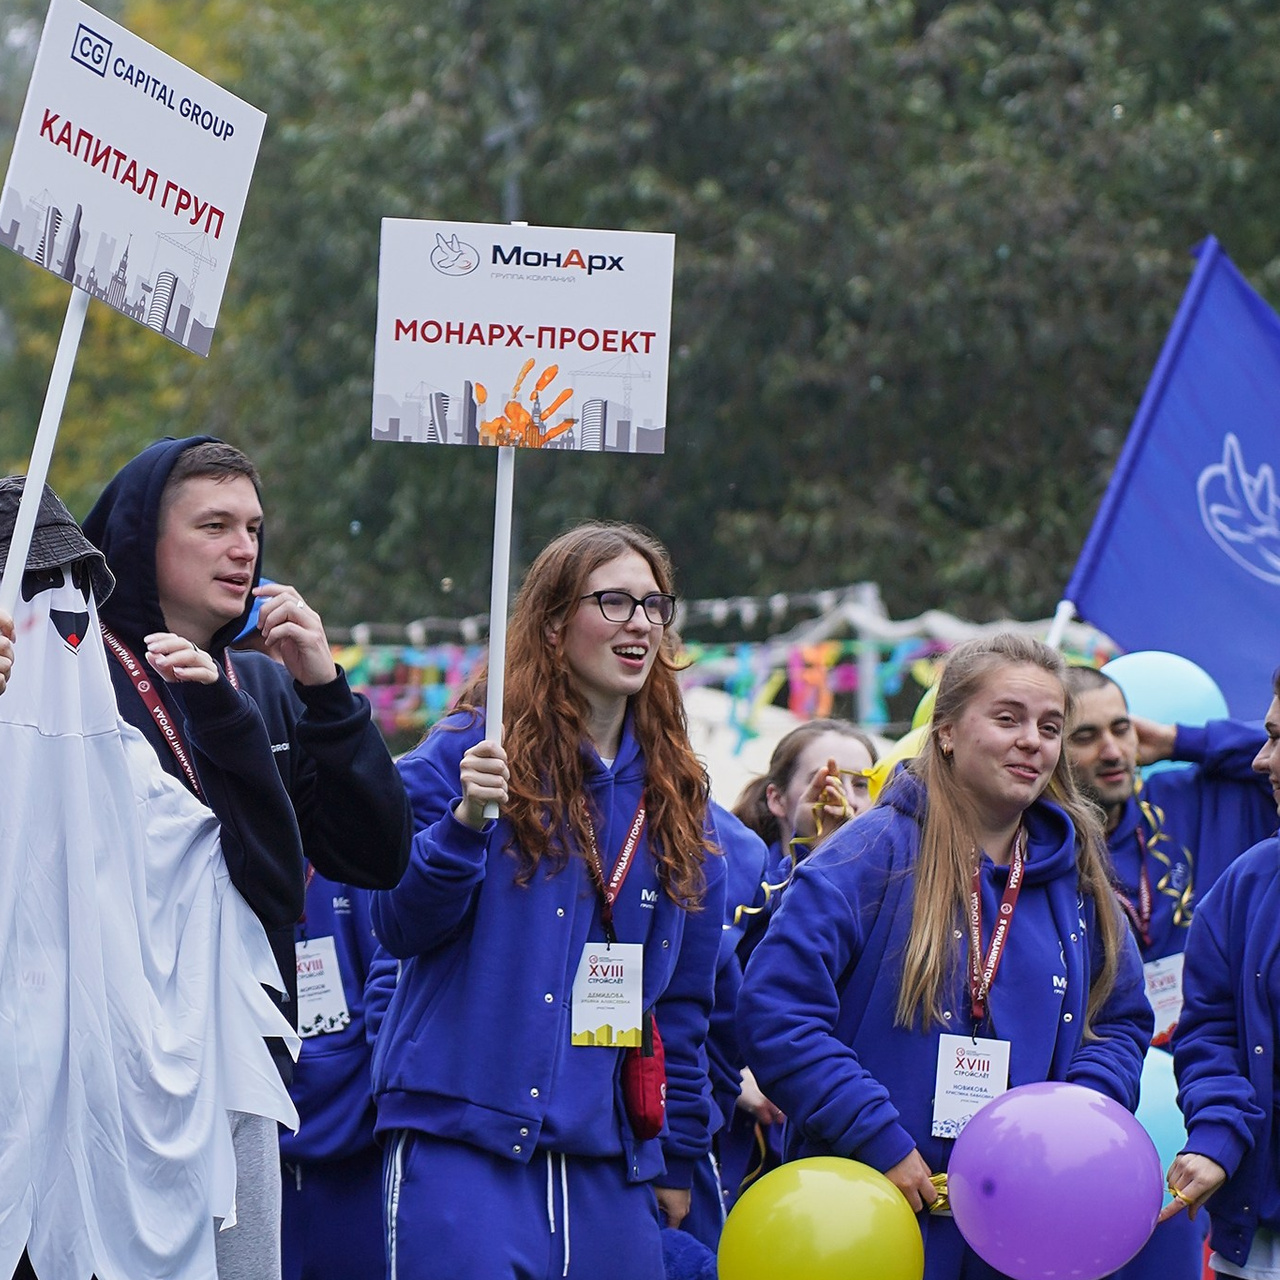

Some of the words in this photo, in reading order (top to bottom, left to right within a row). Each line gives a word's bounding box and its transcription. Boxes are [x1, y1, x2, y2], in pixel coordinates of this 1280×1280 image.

[78, 36, 105, 65] CG
[113, 57, 175, 111] CAPITAL
[179, 97, 235, 142] GROUP
[39, 107, 160, 201] КАПИТАЛ
[160, 179, 226, 240] ГРУП
[491, 244, 625, 275] МонАрх
[490, 272, 524, 280] ГРУППА
[526, 274, 576, 283] КОМПАНИЙ
[394, 318, 656, 354] МОНАРХ-ПРОЕКТ
[131, 669, 140, 677] Я
[153, 705, 177, 740] ГОРОДА
[270, 742, 290, 753] GRO
[612, 837, 635, 882] ФУНДАМЕНТ
[629, 809, 646, 839] ГОРОДА
[987, 925, 1006, 969] ФУНДАМЕНТ
[589, 964, 624, 977] XVIII
[954, 1070, 990, 1079] СТРОЙСЛЁТ
[955, 1057, 990, 1072] XVIII
[953, 1084, 988, 1093] НОВИКОВА
